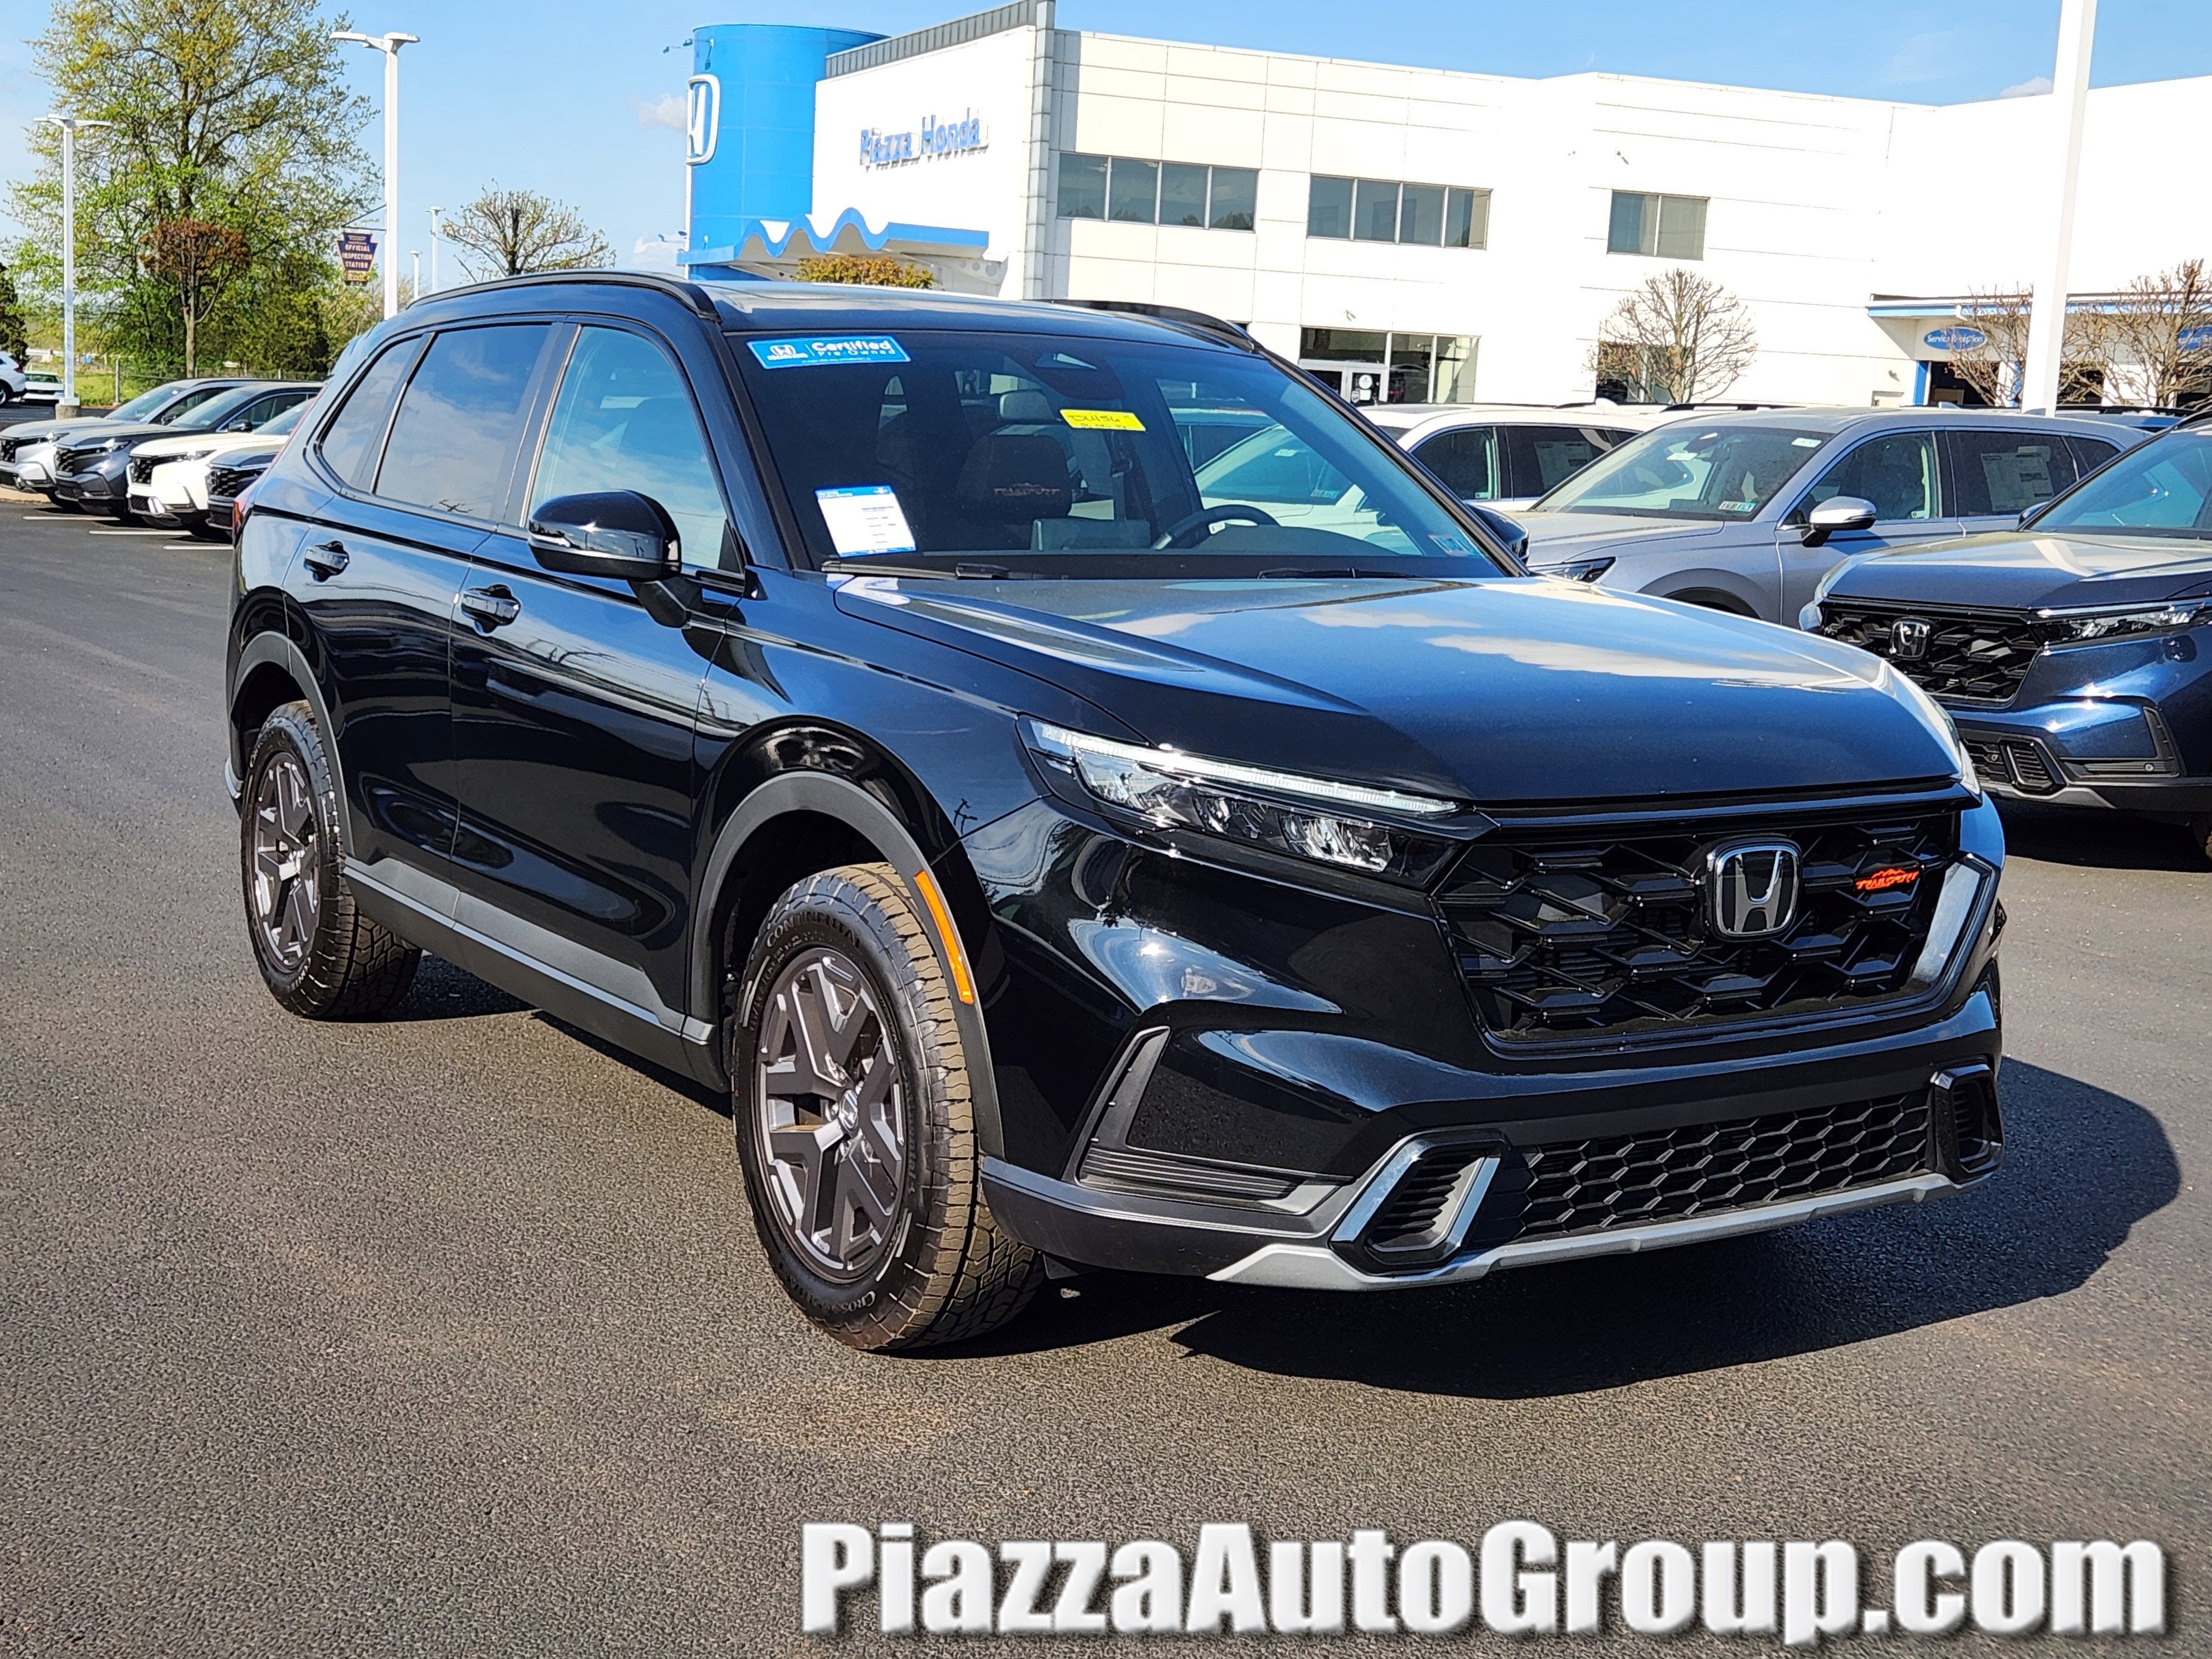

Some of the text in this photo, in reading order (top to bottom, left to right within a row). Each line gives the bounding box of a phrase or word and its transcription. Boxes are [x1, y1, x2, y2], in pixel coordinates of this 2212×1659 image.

[859, 107, 982, 165] Piazza Honda
[345, 244, 371, 252] OFFICIAL
[342, 252, 373, 260] INSPECTION
[345, 260, 368, 269] STATION
[811, 340, 893, 352] Certified
[1855, 870, 1919, 890] TRAILSPORT
